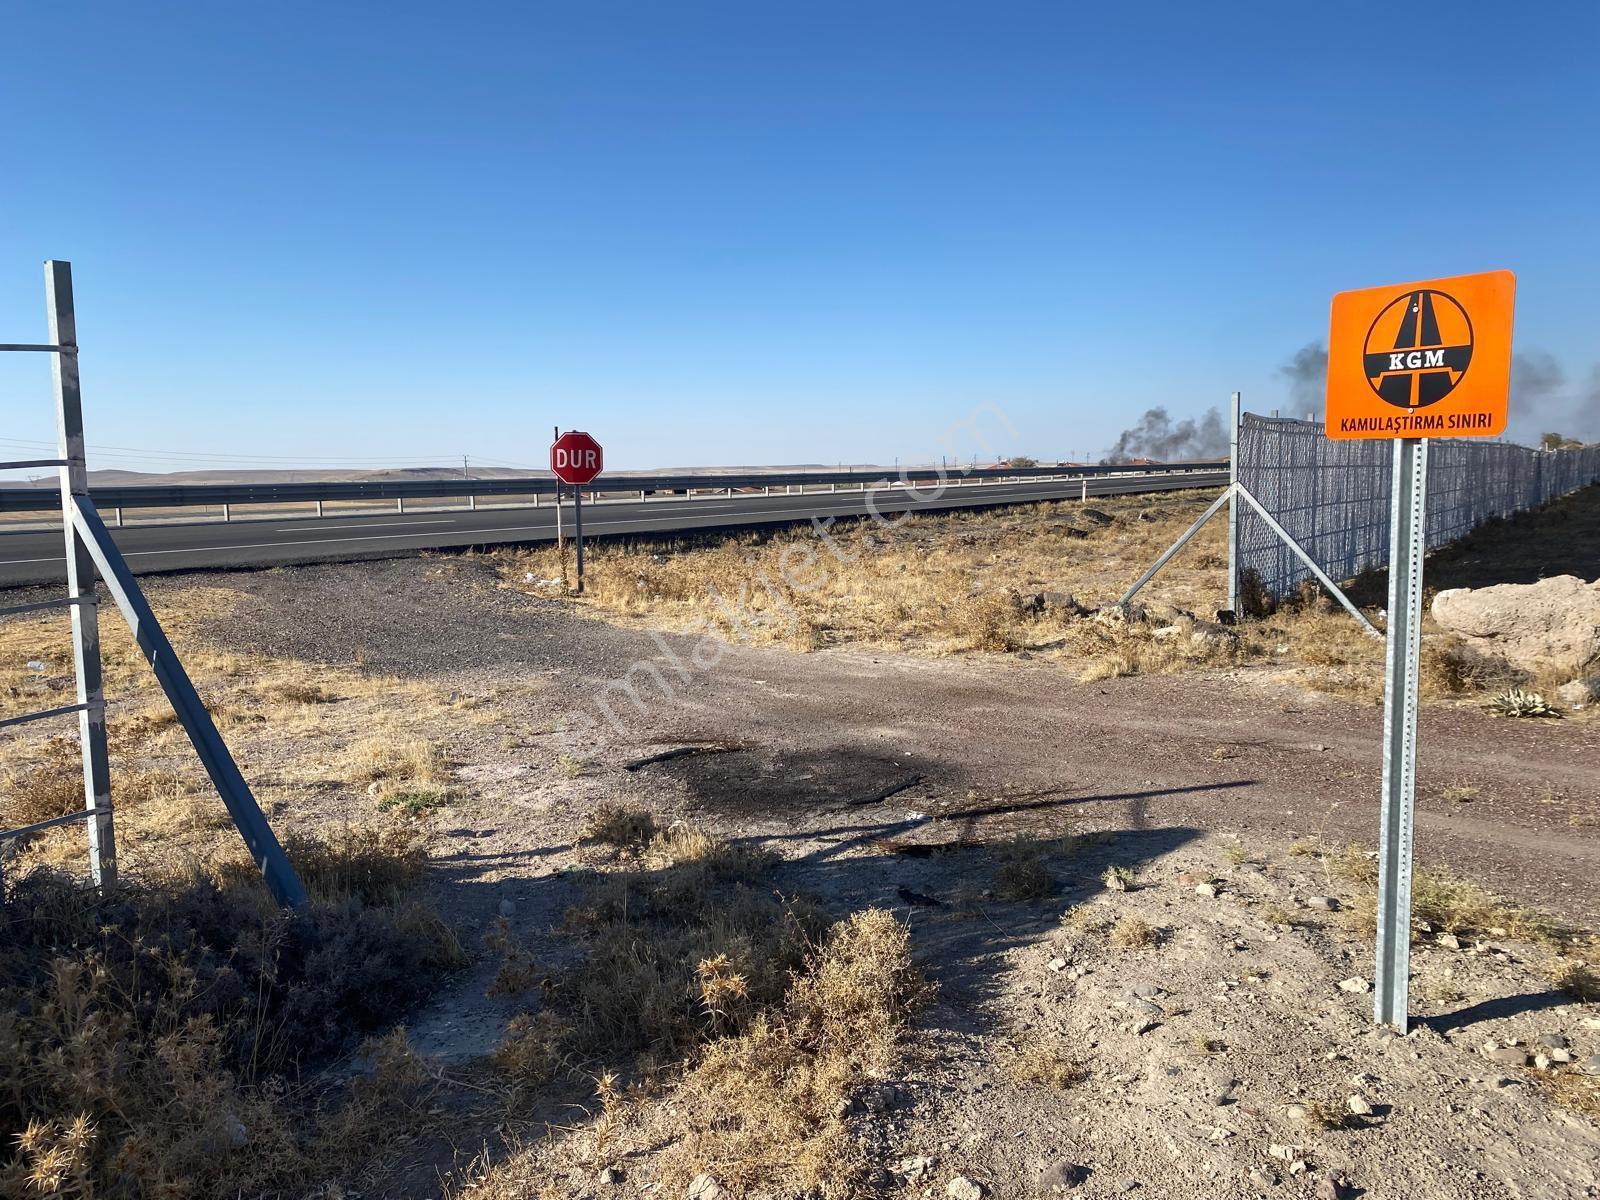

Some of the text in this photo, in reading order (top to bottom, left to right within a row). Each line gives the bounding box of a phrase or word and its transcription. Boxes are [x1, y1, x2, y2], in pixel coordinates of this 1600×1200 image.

[1389, 349, 1445, 370] KGM
[1448, 413, 1492, 429] SINIRI
[556, 448, 597, 469] DUR
